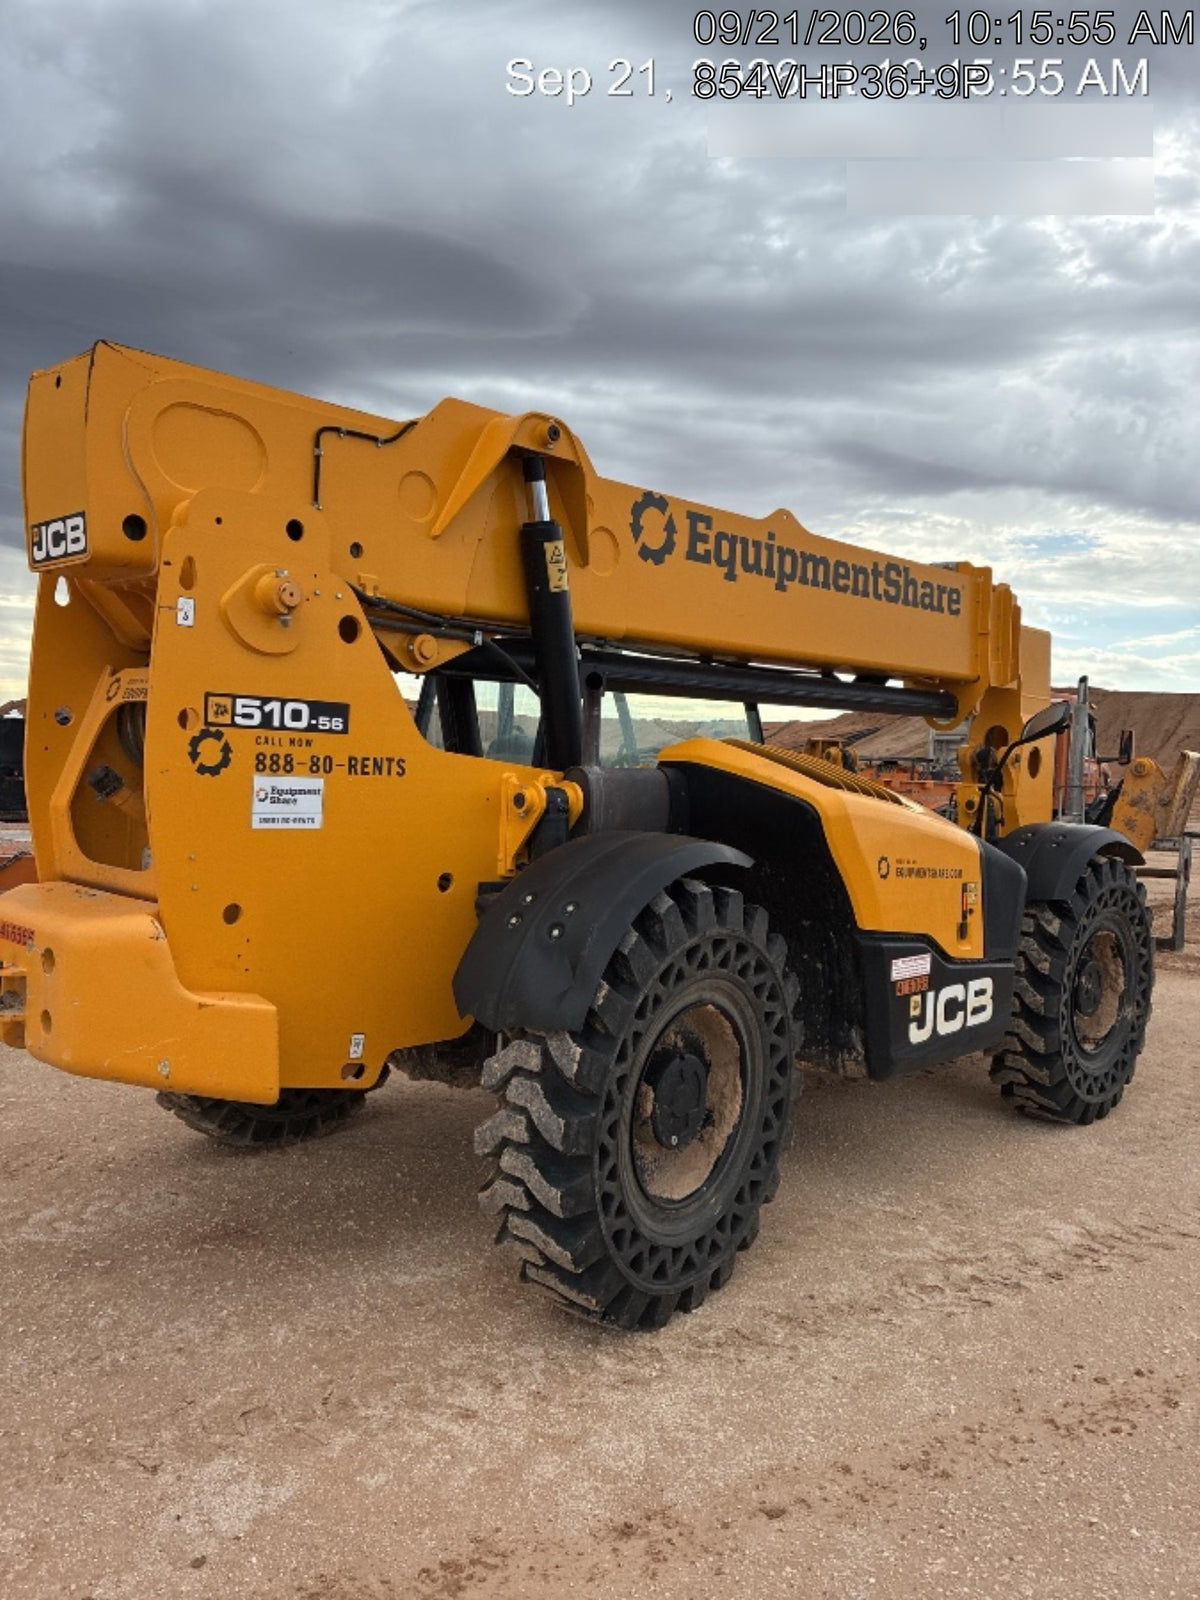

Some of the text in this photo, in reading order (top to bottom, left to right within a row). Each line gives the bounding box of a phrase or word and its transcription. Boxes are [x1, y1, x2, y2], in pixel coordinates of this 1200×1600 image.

[32, 516, 86, 561] JCB
[685, 509, 962, 617] EquipmentShare
[233, 698, 344, 731] 510-56
[255, 735, 314, 748] CALL NOW
[255, 752, 406, 777] 888-80-RENTS
[908, 977, 993, 1045] JCB
